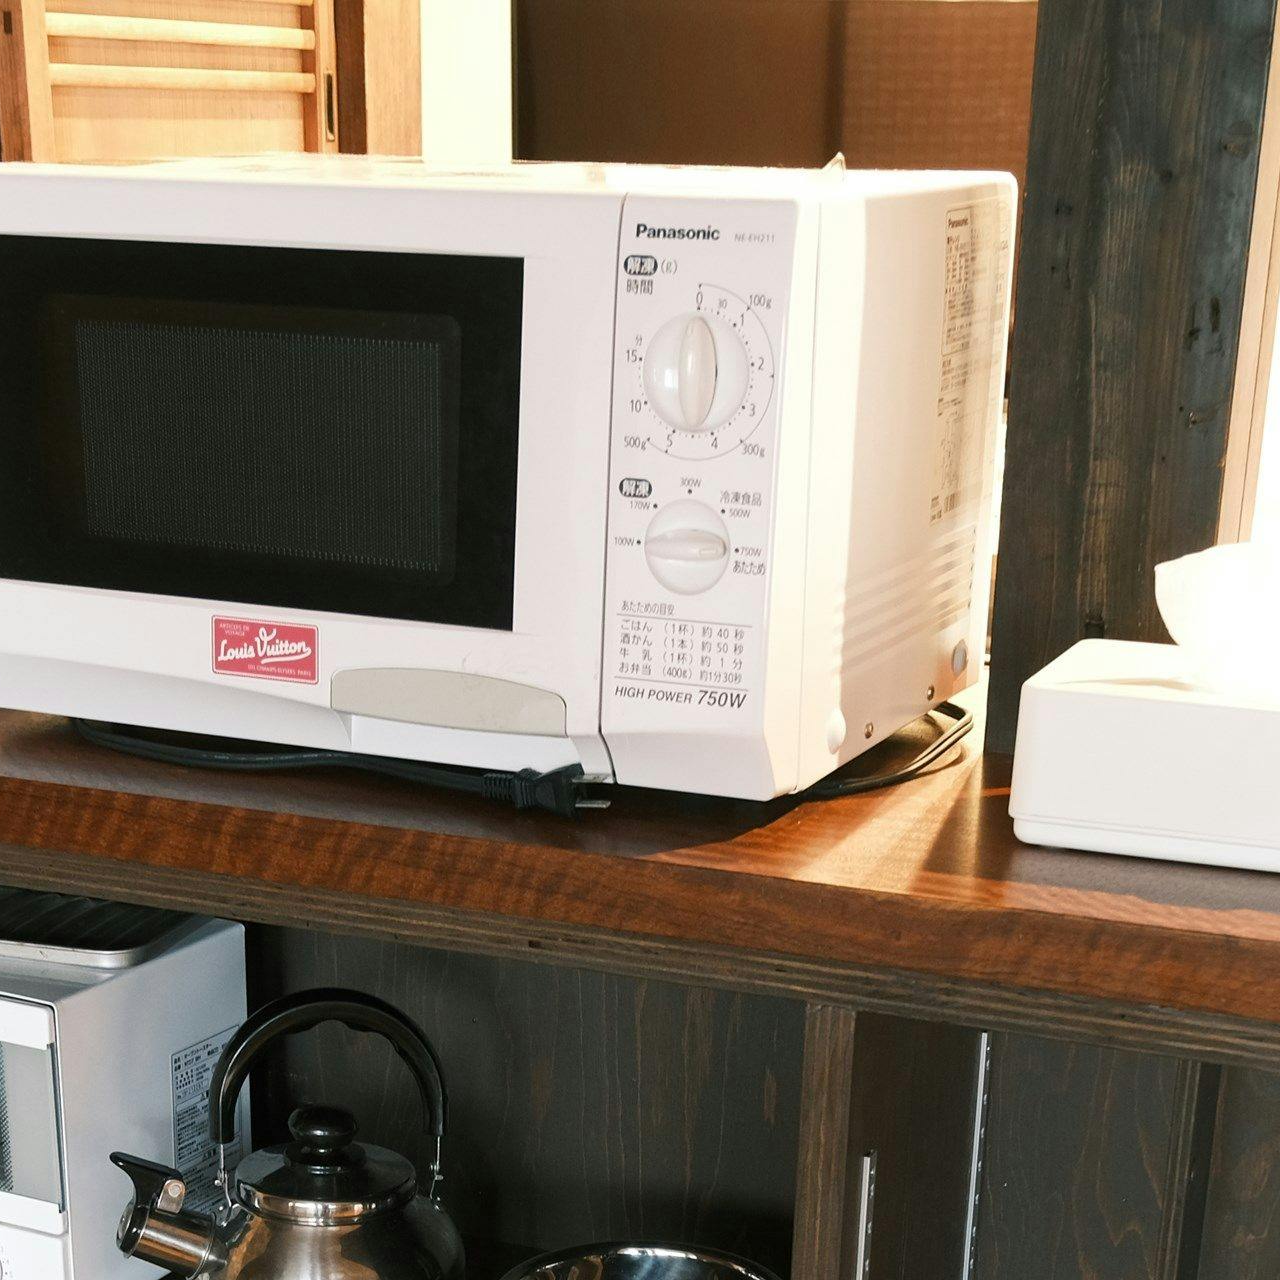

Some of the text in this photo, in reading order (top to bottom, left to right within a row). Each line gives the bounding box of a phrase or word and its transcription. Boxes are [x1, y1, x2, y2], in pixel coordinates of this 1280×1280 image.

[636, 223, 721, 241] Panasonic
[626, 279, 654, 295] 時間
[696, 291, 704, 305] 0
[748, 294, 773, 309] 100g
[740, 313, 745, 327] 1
[625, 349, 638, 363] 15
[757, 356, 765, 371] 2
[630, 399, 642, 413] 10
[749, 403, 756, 417] 3
[624, 436, 647, 451] 500g
[666, 434, 673, 448] 5
[711, 435, 719, 450] 4
[742, 444, 765, 458] 300g
[630, 501, 651, 510] 170W
[720, 491, 762, 507] 冷凍食品
[729, 508, 751, 518] 500W
[614, 537, 635, 547] 100W
[733, 561, 766, 576] あたため
[621, 600, 675, 615] あたための目安
[621, 619, 653, 633] ごはん
[717, 628, 729, 640] 40
[218, 627, 312, 664] Louis Vuitton
[620, 633, 653, 647] 酒かん
[717, 642, 729, 653] 50
[618, 661, 652, 676] お弁当
[614, 686, 747, 709] HIGH POWER 750W
